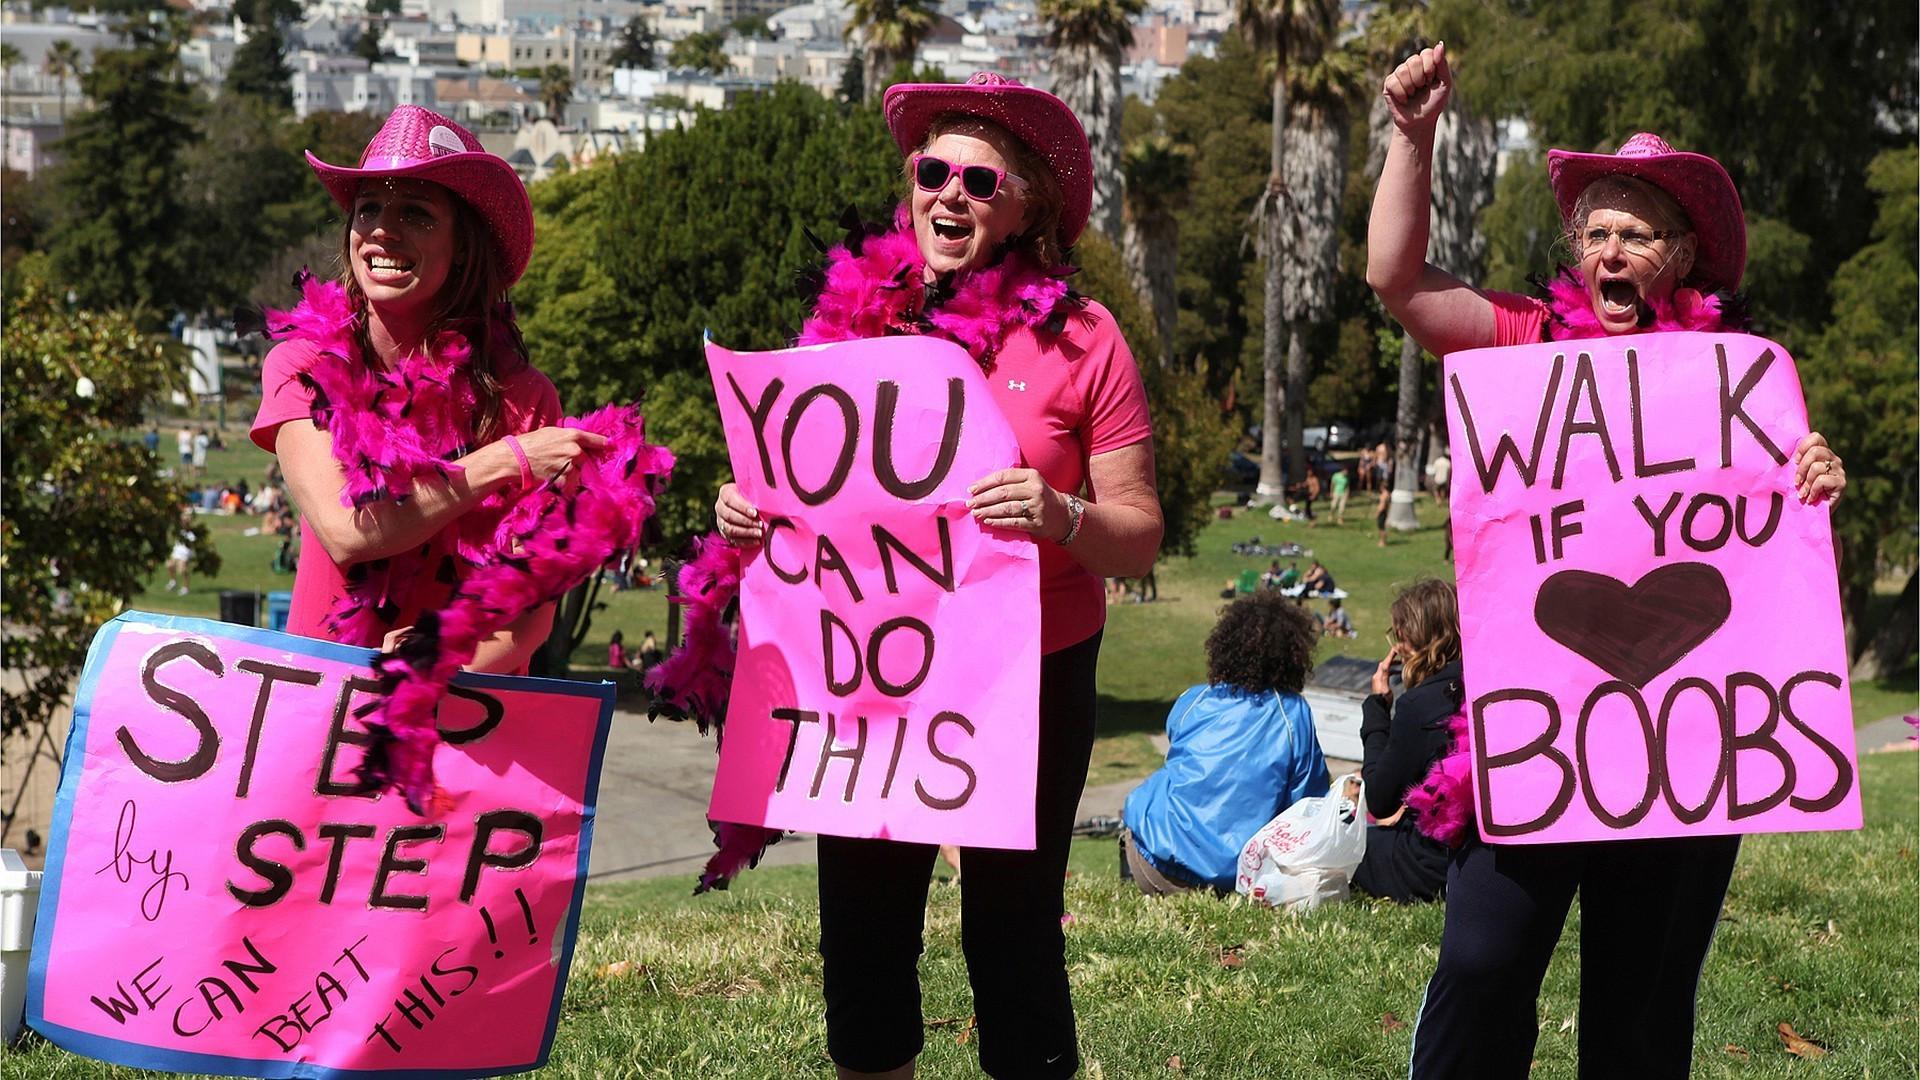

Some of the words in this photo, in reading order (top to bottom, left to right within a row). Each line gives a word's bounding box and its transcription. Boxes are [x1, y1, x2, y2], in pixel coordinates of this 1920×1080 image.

[725, 371, 966, 506] YOU
[1450, 343, 1790, 494] WALK
[763, 516, 955, 603] CAN
[1530, 500, 1585, 564] IF
[1633, 491, 1783, 557] YOU
[820, 608, 935, 698] DO
[771, 710, 977, 811] THIS
[1472, 670, 1853, 836] BOOBS
[95, 799, 190, 922] by
[225, 809, 543, 912] STEP
[90, 956, 174, 1024] WE
[172, 937, 277, 1038] CAN
[252, 935, 375, 1054] BEAT
